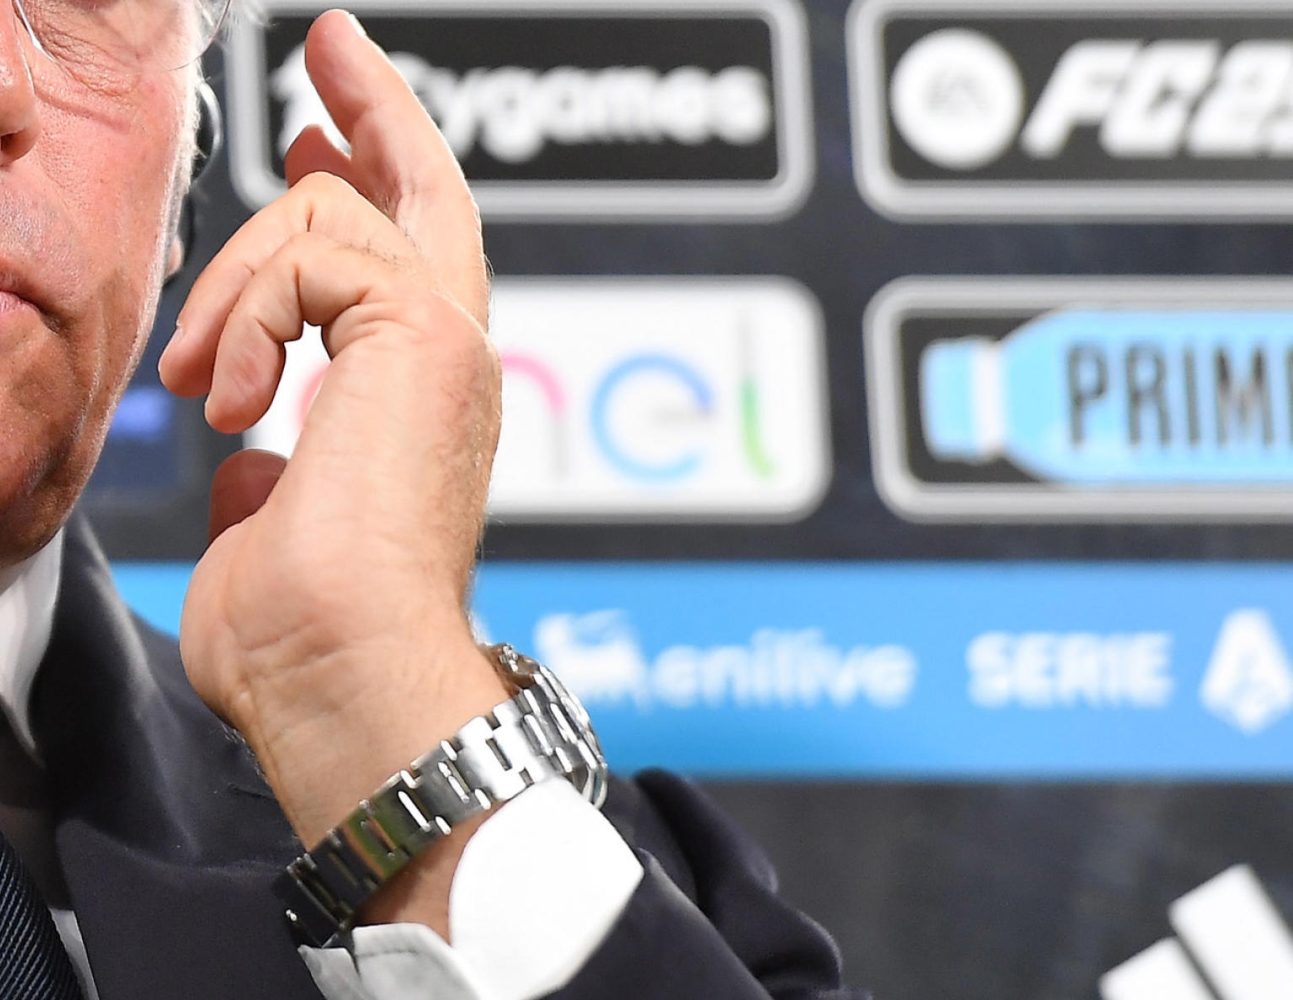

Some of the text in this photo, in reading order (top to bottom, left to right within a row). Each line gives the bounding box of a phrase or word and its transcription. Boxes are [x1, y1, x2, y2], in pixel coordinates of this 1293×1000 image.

[396, 50, 771, 163] ygames
[1020, 38, 1293, 160] FC2
[296, 308, 778, 486] nel
[1066, 344, 1293, 448] PRIM
[964, 632, 1172, 708] SERIE
